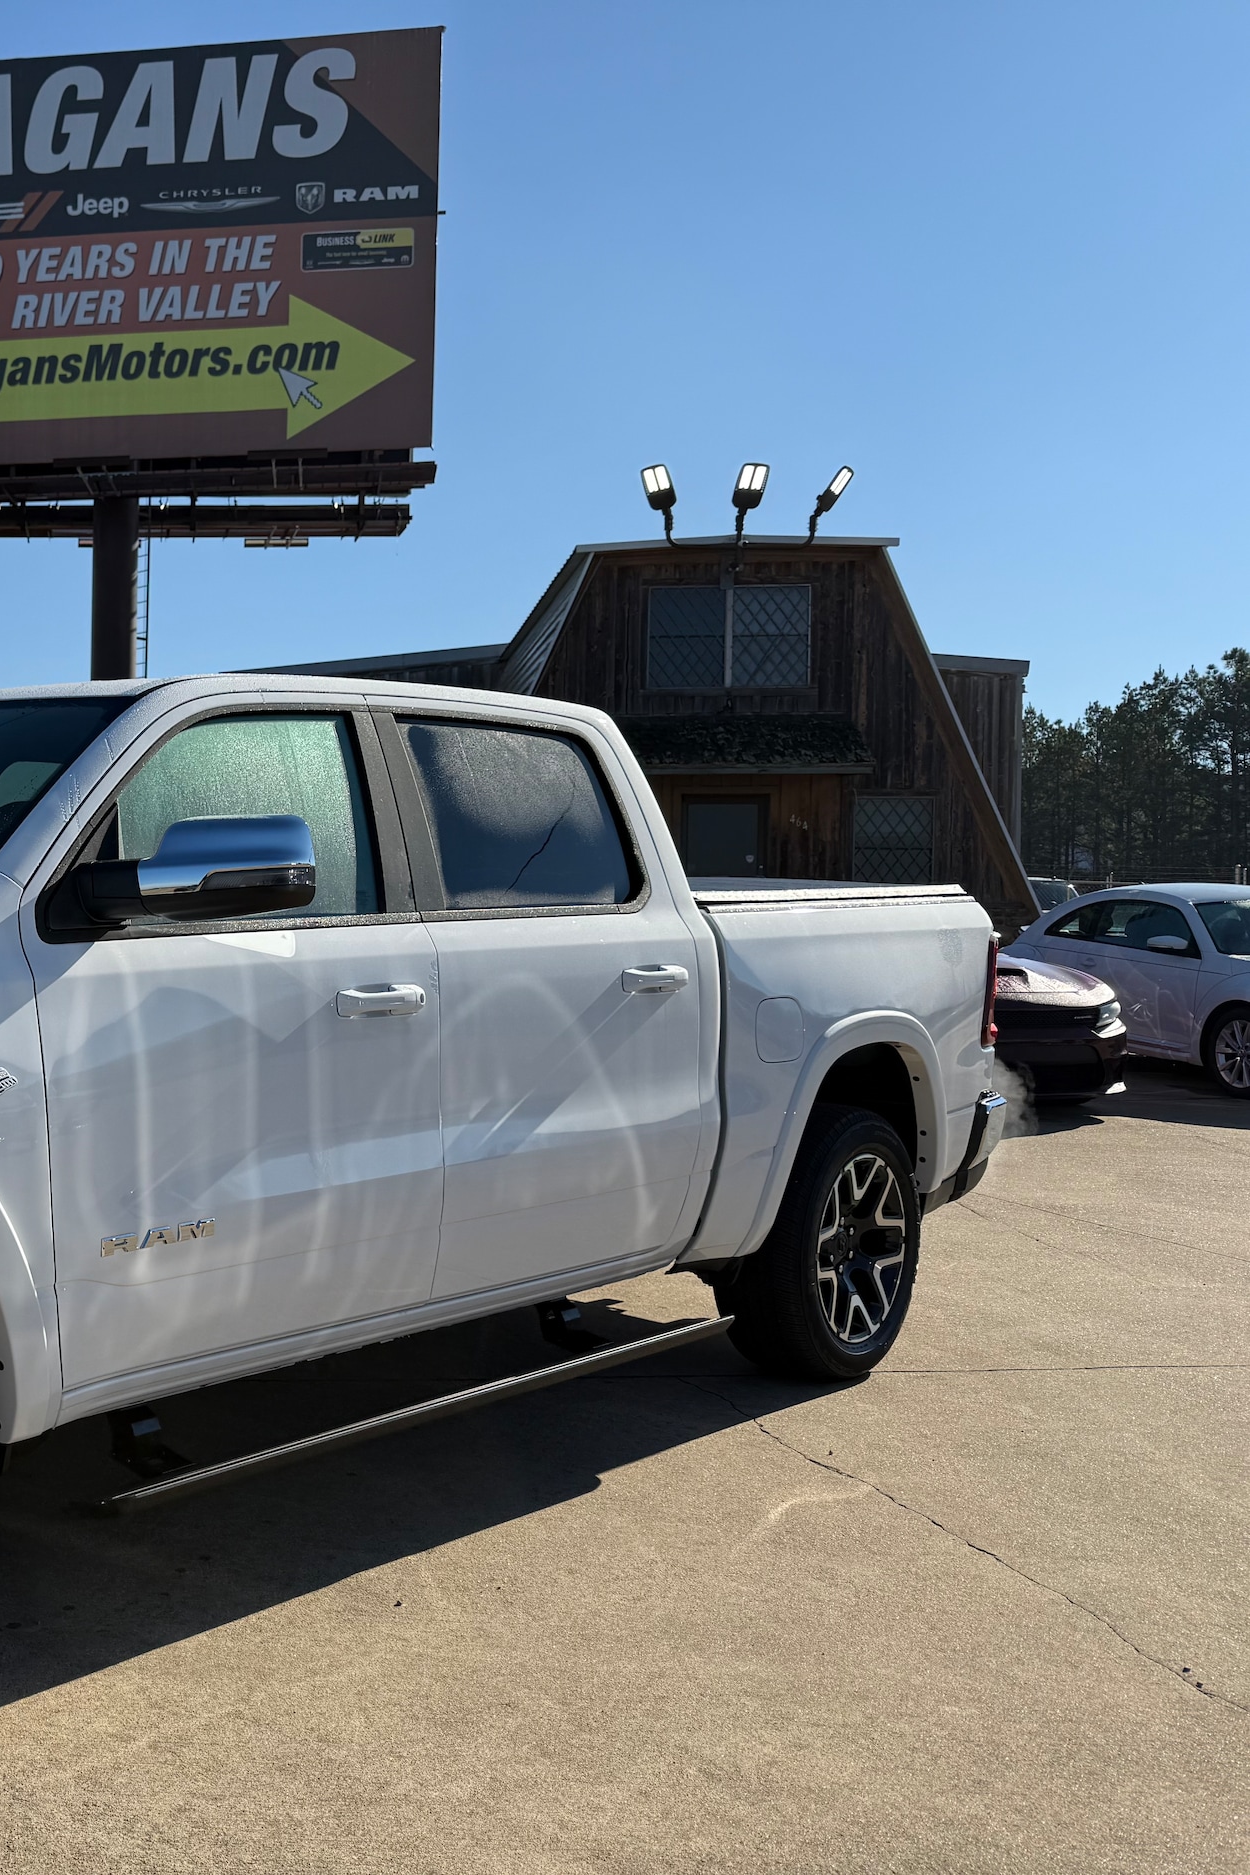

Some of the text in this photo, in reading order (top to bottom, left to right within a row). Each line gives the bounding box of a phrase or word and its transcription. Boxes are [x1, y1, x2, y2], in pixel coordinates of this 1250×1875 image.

[158, 185, 263, 200] CHRYSLER
[333, 184, 420, 203] RAM
[66, 193, 130, 218] Jeep
[373, 233, 397, 244] LINK
[14, 234, 277, 284] YEARS IN THE
[11, 280, 282, 330] RIVER VALLEY
[100, 1217, 216, 1258] RAM
